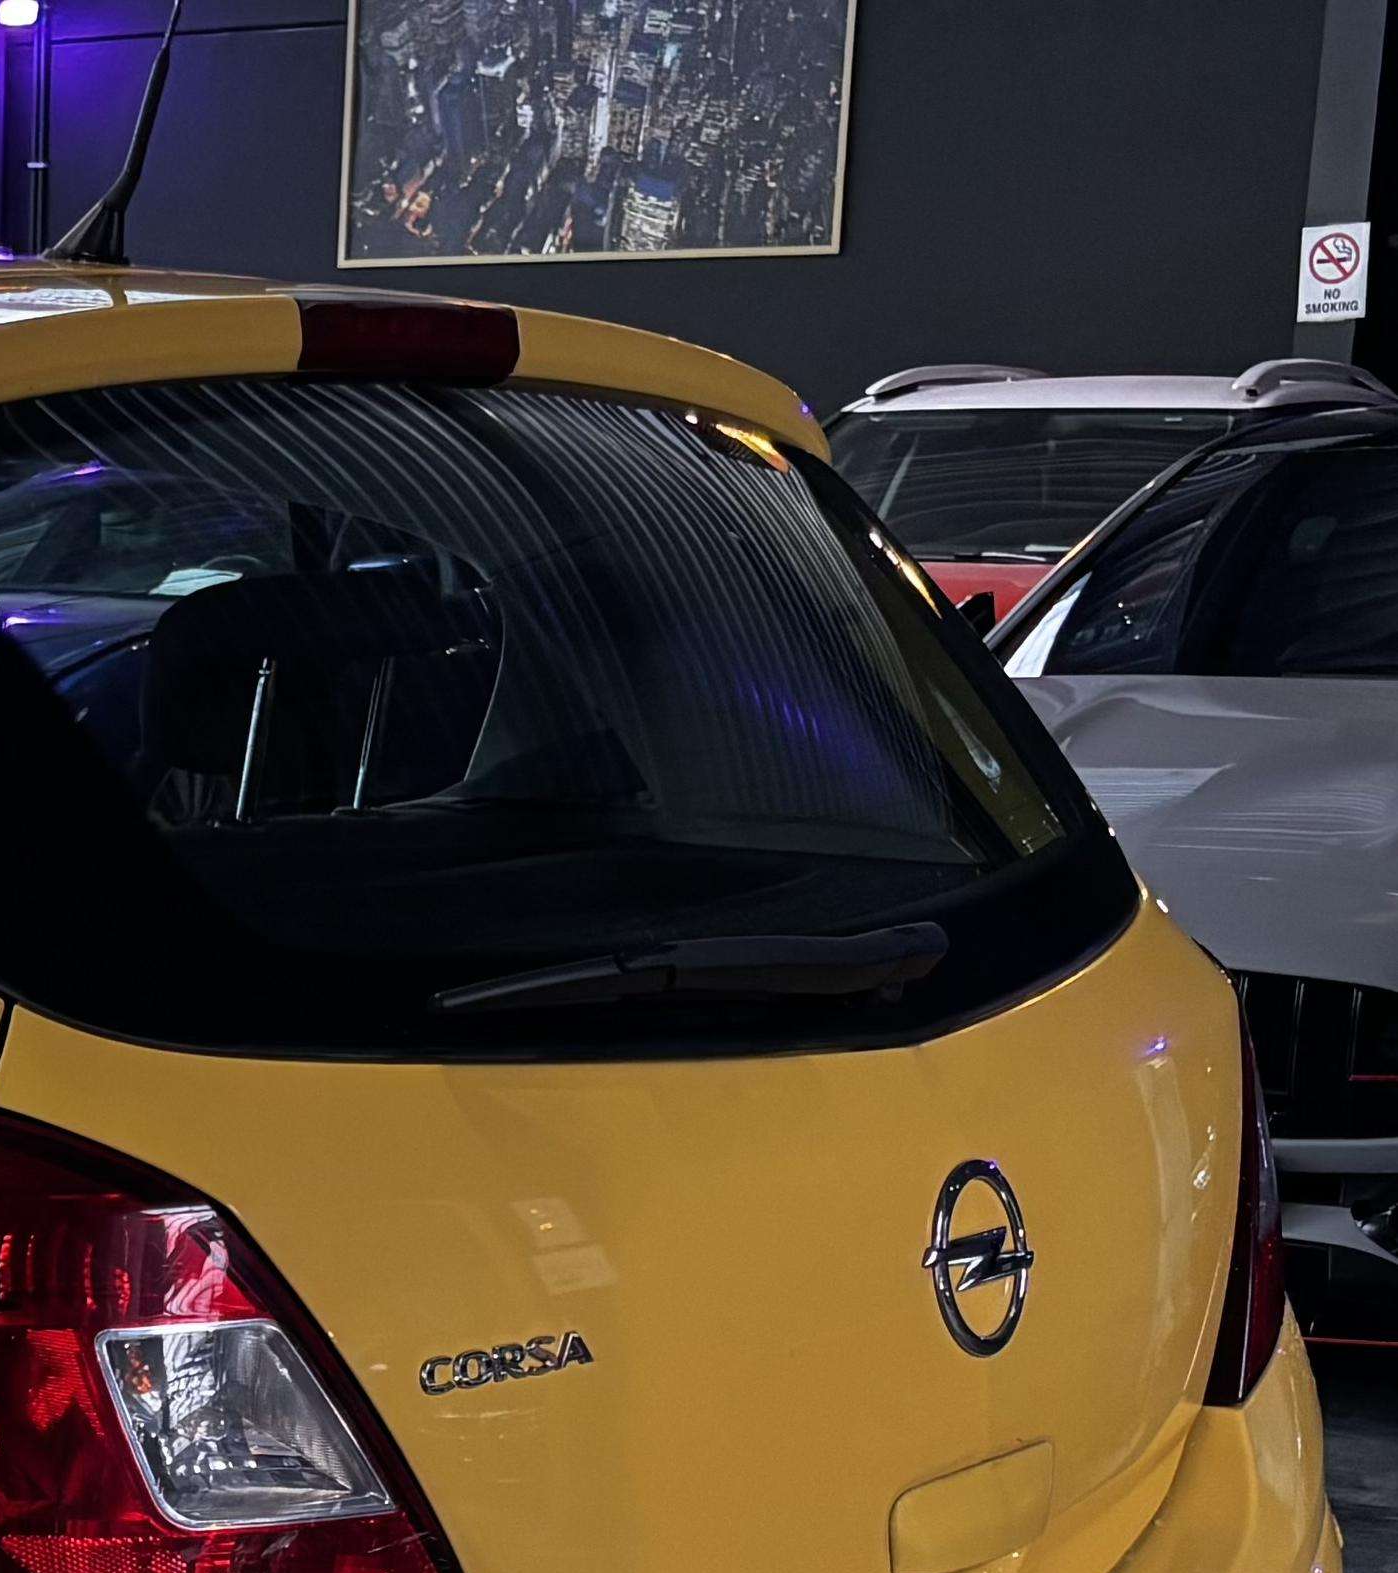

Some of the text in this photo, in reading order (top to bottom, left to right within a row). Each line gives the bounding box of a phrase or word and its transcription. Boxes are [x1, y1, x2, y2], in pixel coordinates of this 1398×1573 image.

[1324, 288, 1341, 300] NO
[1305, 301, 1359, 314] SMOKING
[419, 1330, 595, 1396] CORSA
